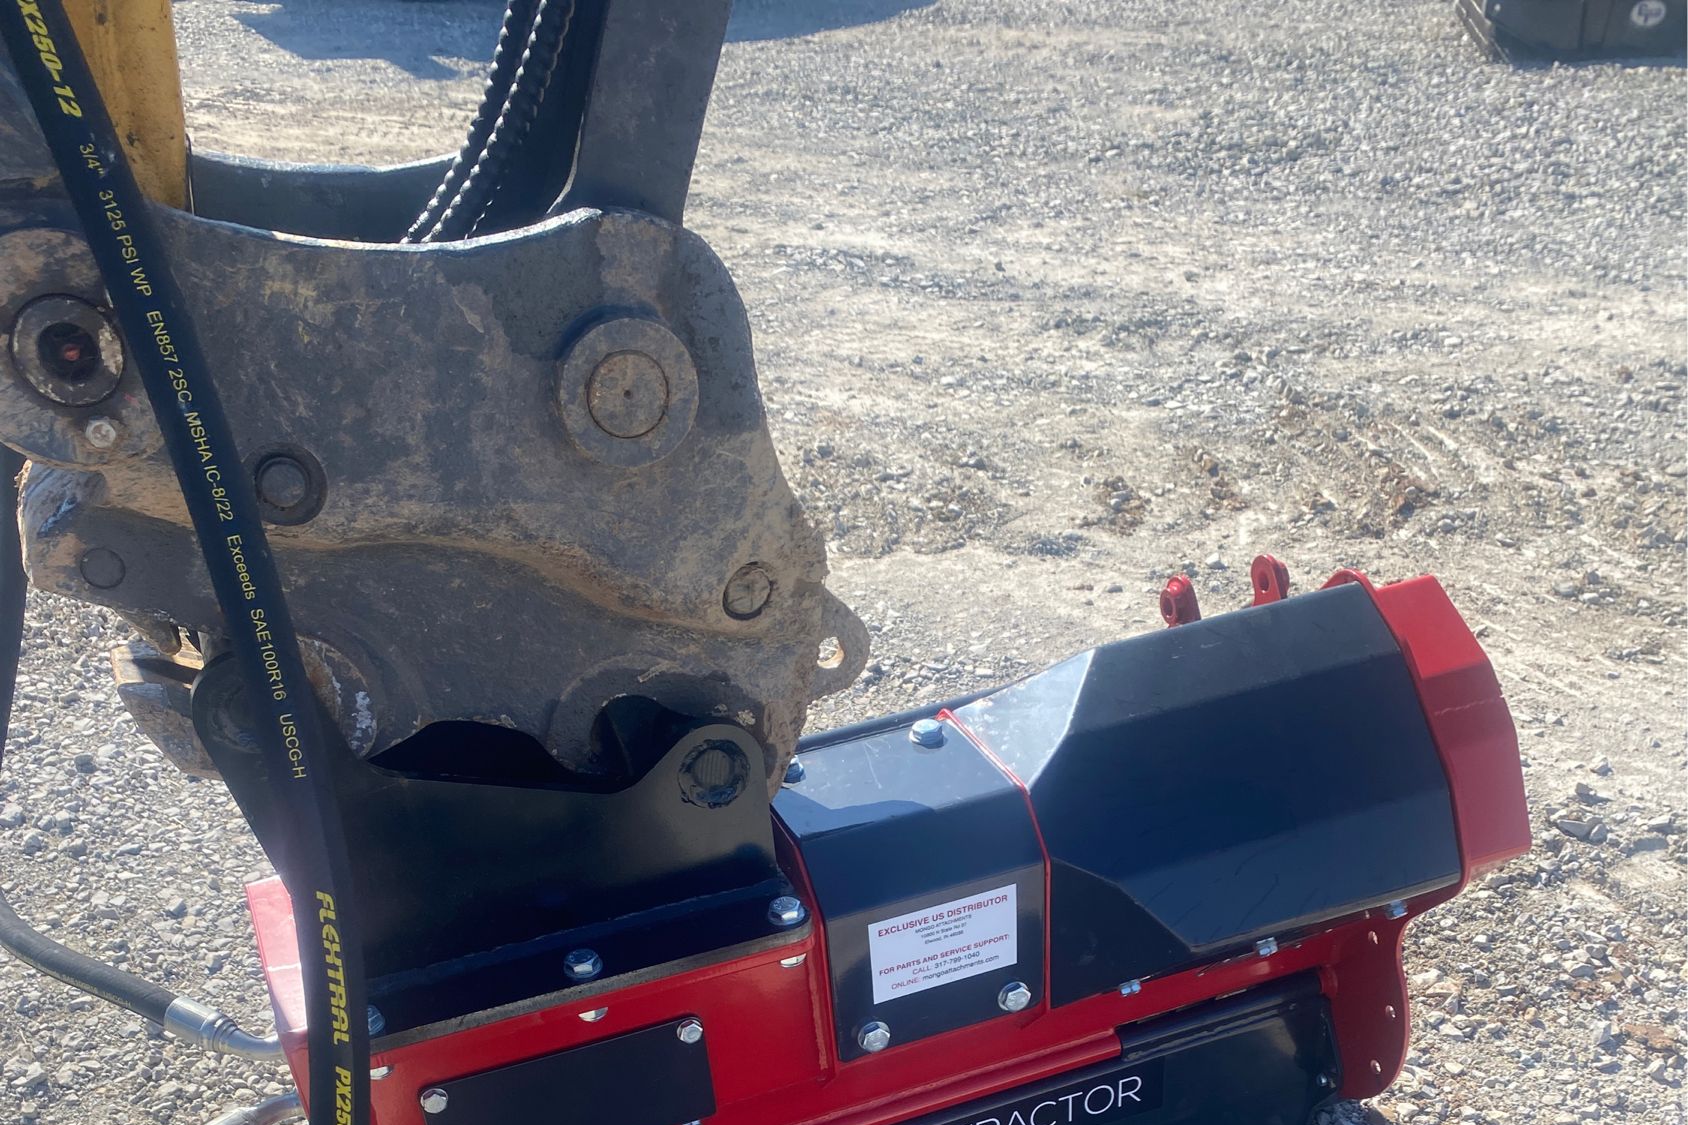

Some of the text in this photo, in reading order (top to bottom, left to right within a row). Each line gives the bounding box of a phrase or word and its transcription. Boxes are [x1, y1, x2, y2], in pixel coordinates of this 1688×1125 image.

[17, 0, 82, 118] X250-12
[98, 190, 126, 231] 3125
[116, 234, 140, 264] PSI
[130, 267, 152, 297] WP
[146, 310, 179, 363] EN857
[168, 368, 192, 403] 2SC
[184, 411, 214, 463] MSHA
[203, 465, 234, 522] IC-8/22
[227, 534, 256, 600] Exceeds
[250, 608, 287, 701] SAE100R16
[279, 713, 307, 779] USCG-H
[877, 894, 1008, 937] EXCLUSIVE US DISTRIBUTOR
[316, 890, 350, 1046] FLEXTRAL
[879, 966, 895, 976] FOR
[896, 958, 921, 972] PARTS
[922, 954, 938, 964] AND
[940, 944, 972, 959] SERVICE
[891, 954, 1000, 990] ONLINE: mongoattachments.com
[934, 951, 981, 969] 317-799-1040
